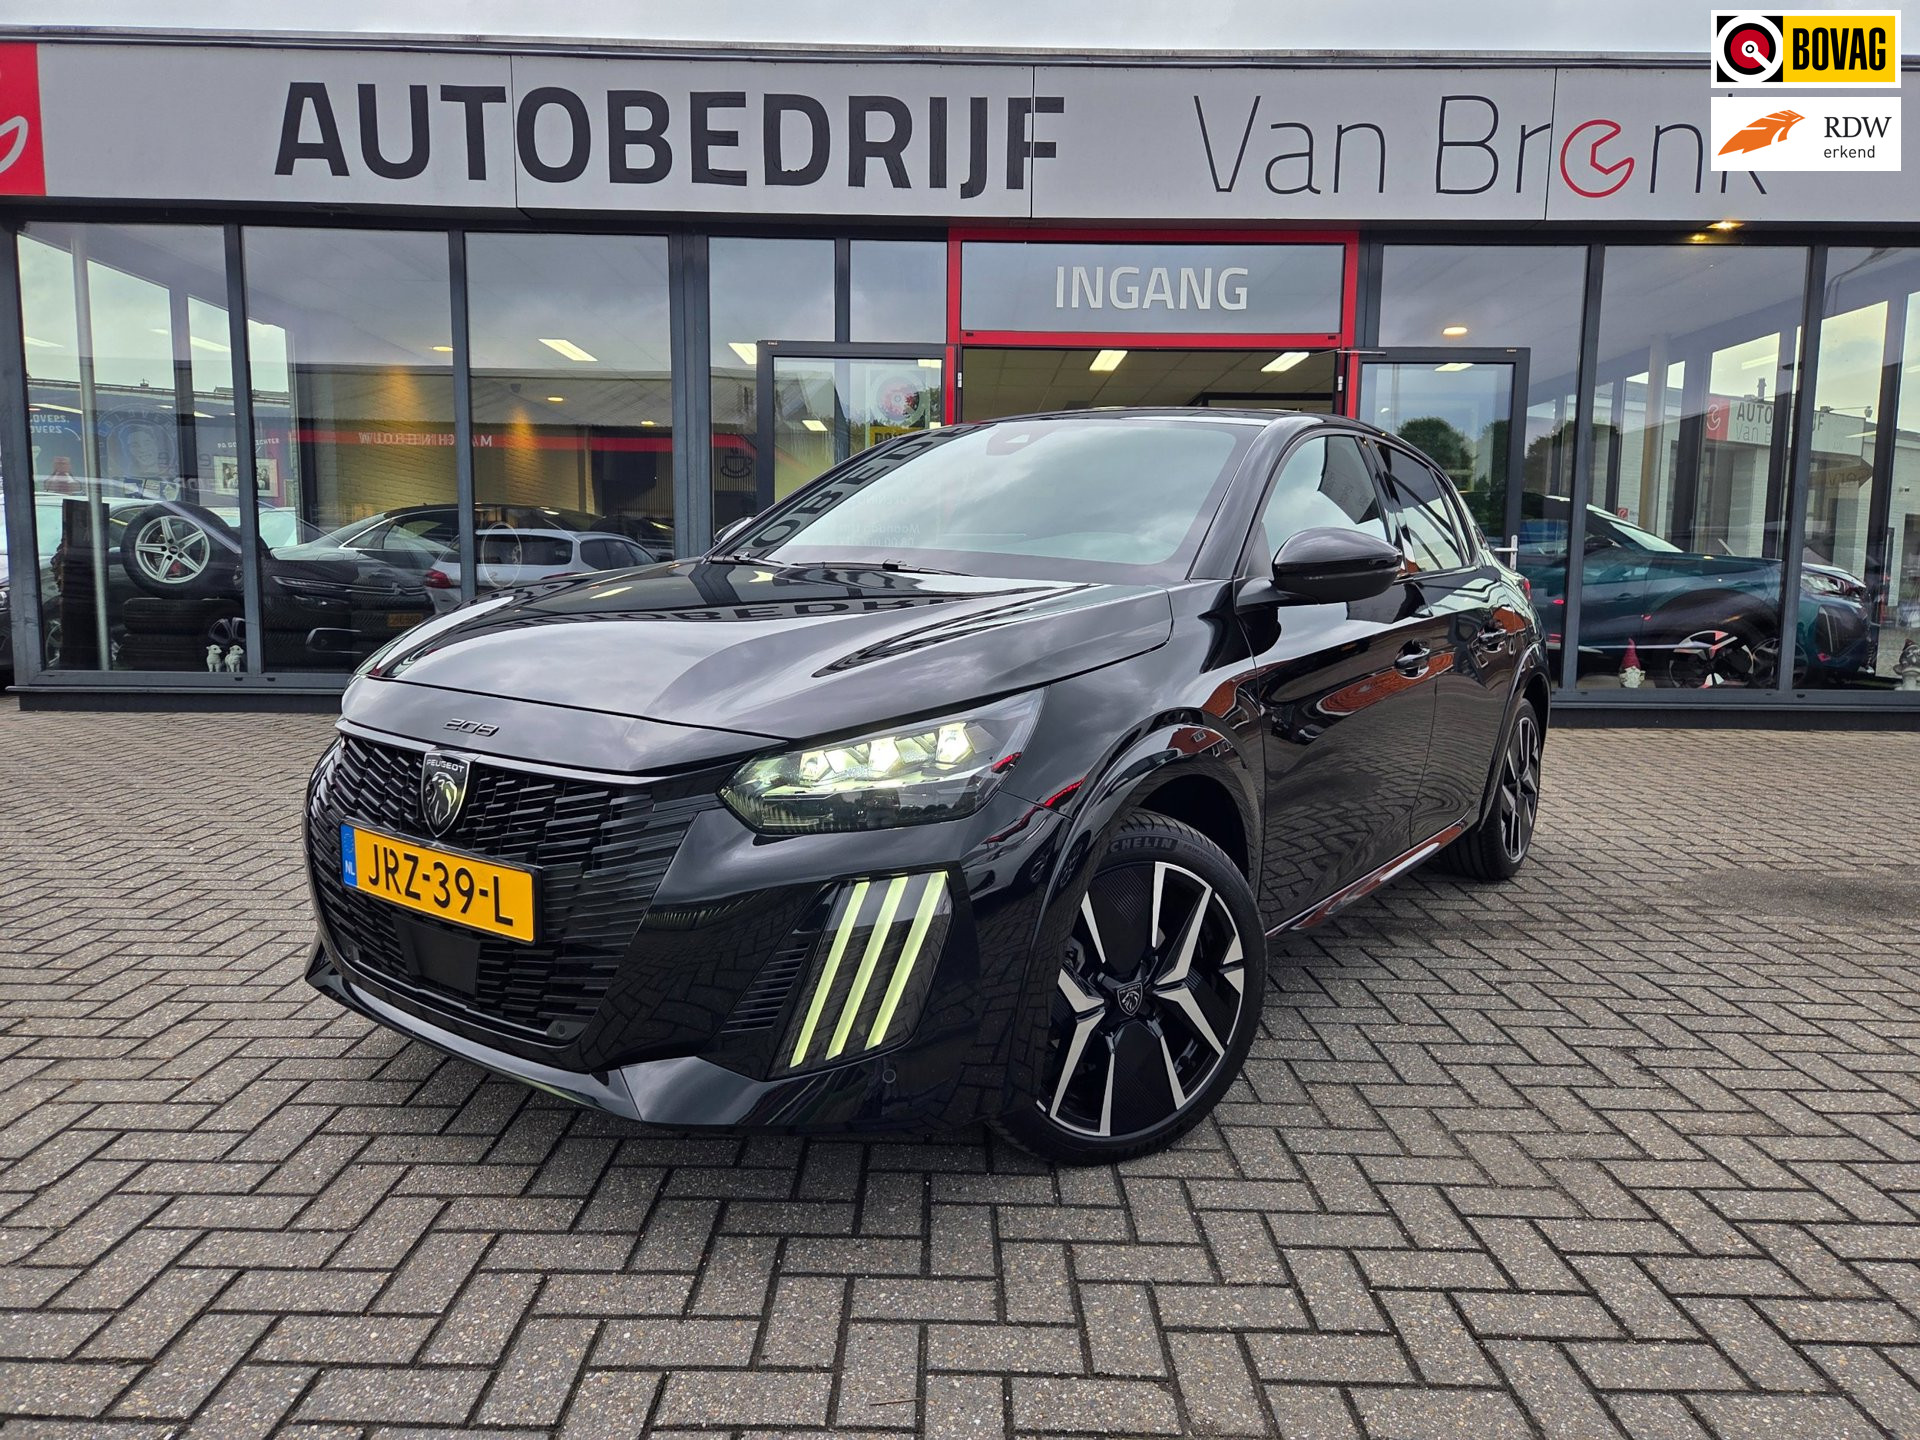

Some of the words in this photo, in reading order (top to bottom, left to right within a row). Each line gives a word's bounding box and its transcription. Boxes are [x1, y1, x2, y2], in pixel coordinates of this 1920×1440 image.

[274, 82, 1065, 199] AUTOBEDRIJF
[1193, 95, 1387, 195] Van
[1056, 266, 1249, 311] INGANG
[443, 718, 501, 737] 208
[426, 758, 465, 773] PEUGEOT
[1109, 838, 1173, 853] CHELIN
[344, 859, 356, 876] NL
[368, 843, 514, 927] JRZ-39-L
